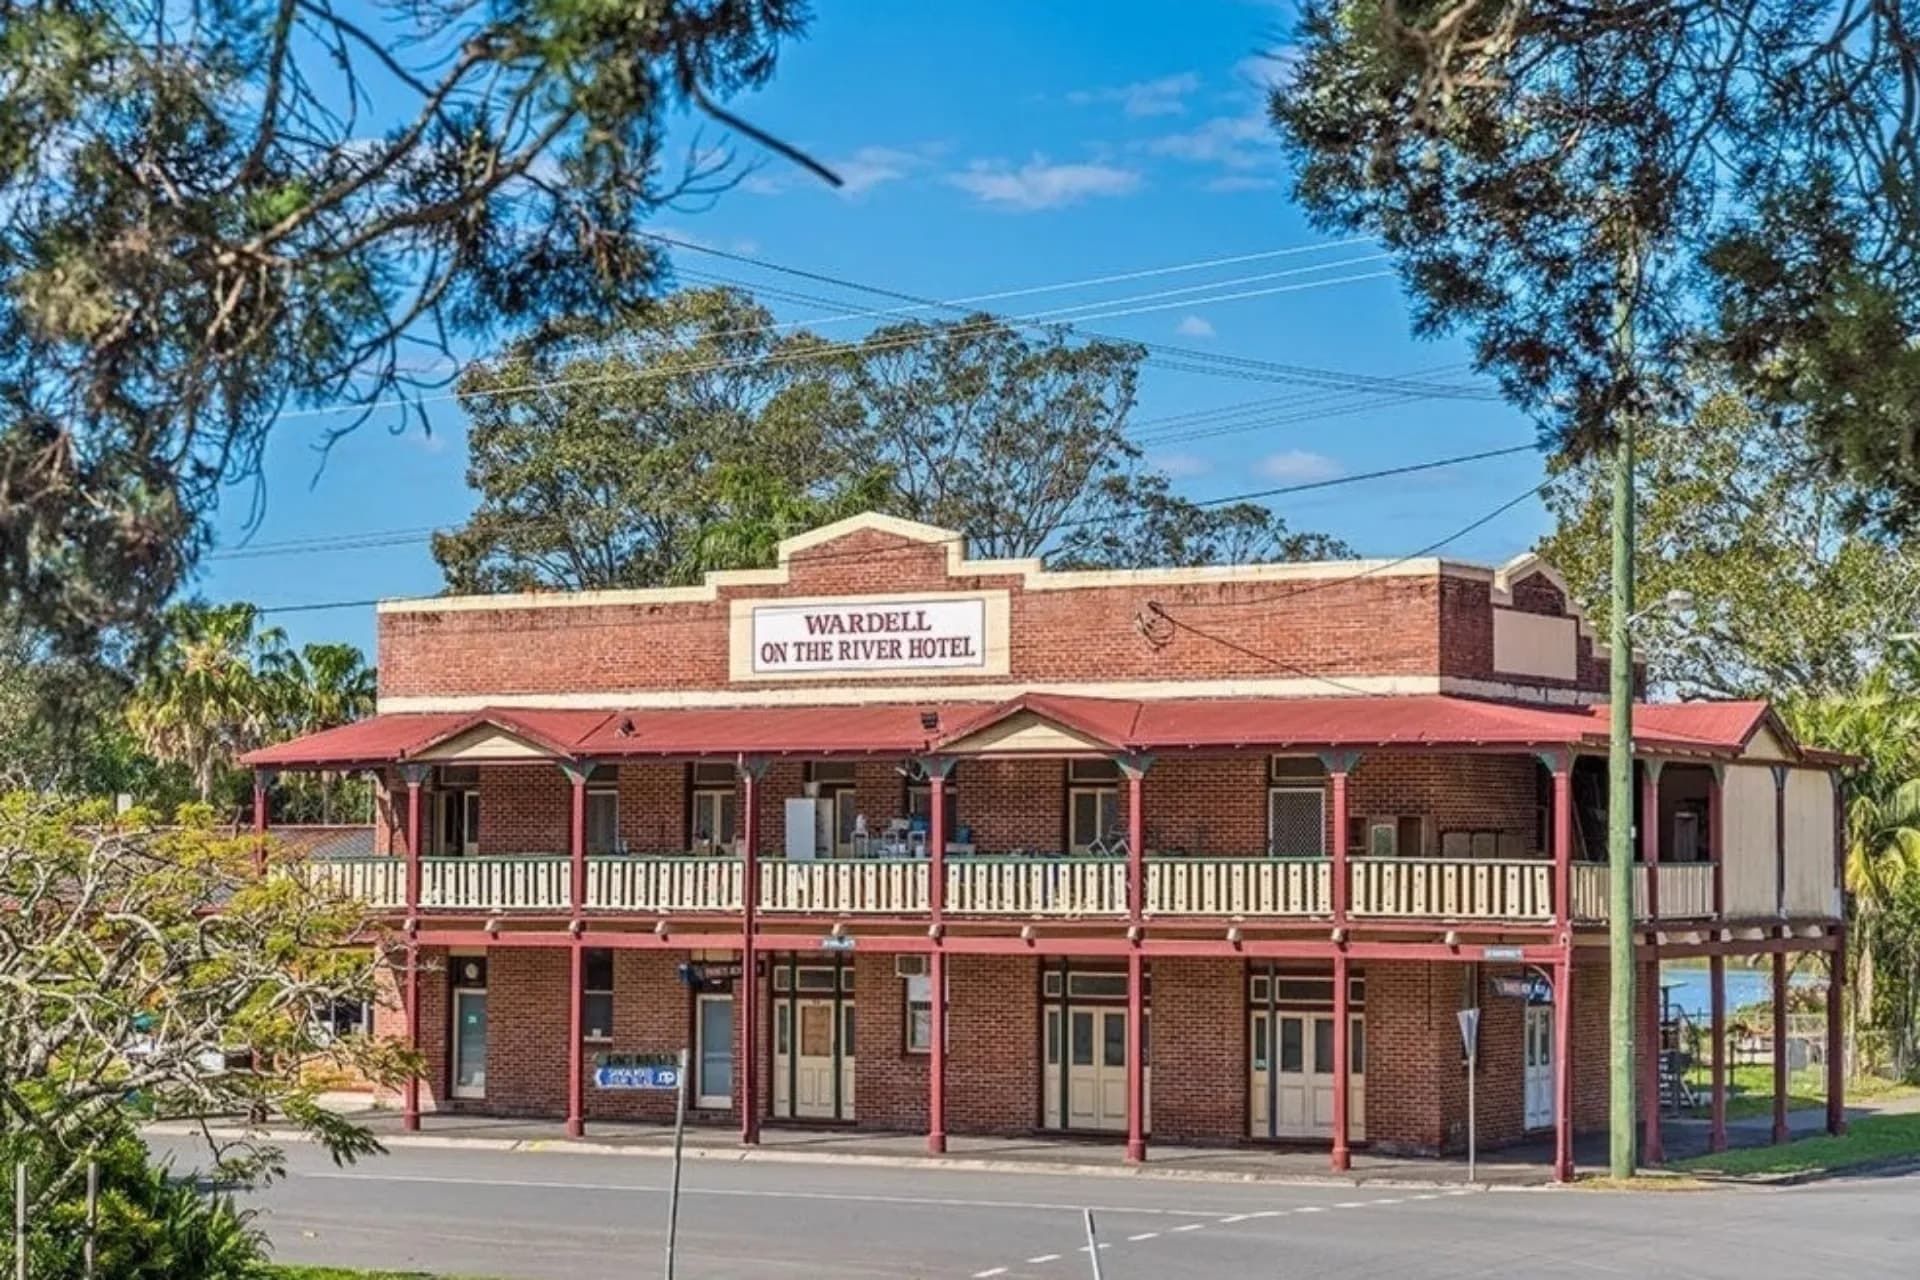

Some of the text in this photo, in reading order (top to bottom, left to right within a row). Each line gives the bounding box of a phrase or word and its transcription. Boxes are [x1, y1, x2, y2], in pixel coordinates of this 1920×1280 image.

[804, 611, 931, 634] WARDELL
[761, 636, 975, 664] ON THE RIVER HOTEL
